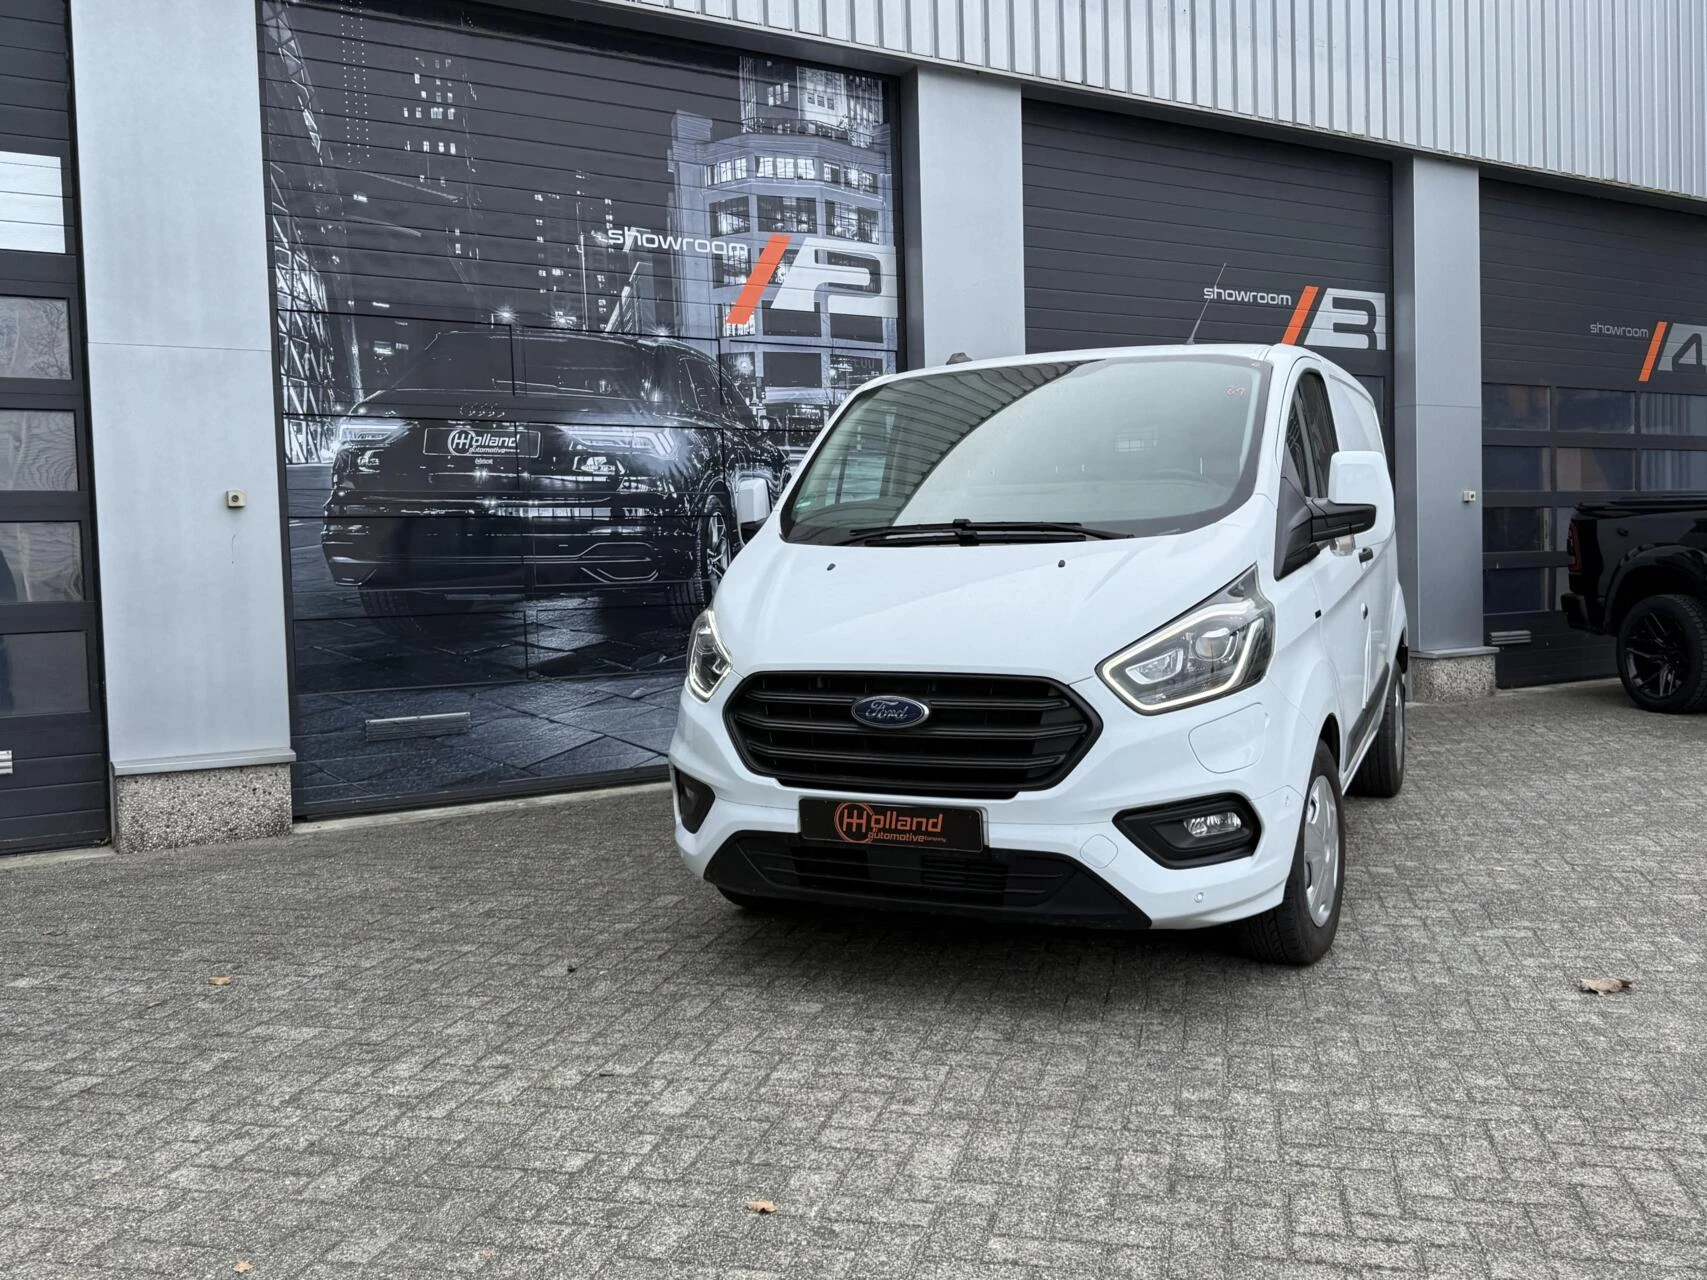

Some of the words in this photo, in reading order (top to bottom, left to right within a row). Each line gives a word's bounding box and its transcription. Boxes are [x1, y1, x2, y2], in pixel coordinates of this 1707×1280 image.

[607, 226, 748, 256] showroom
[1203, 285, 1292, 306] showroom
[1589, 321, 1649, 338] showroom
[449, 431, 520, 452] Holland
[865, 699, 909, 720] Ford
[838, 805, 944, 834] Holland
[868, 831, 925, 843] automotive
